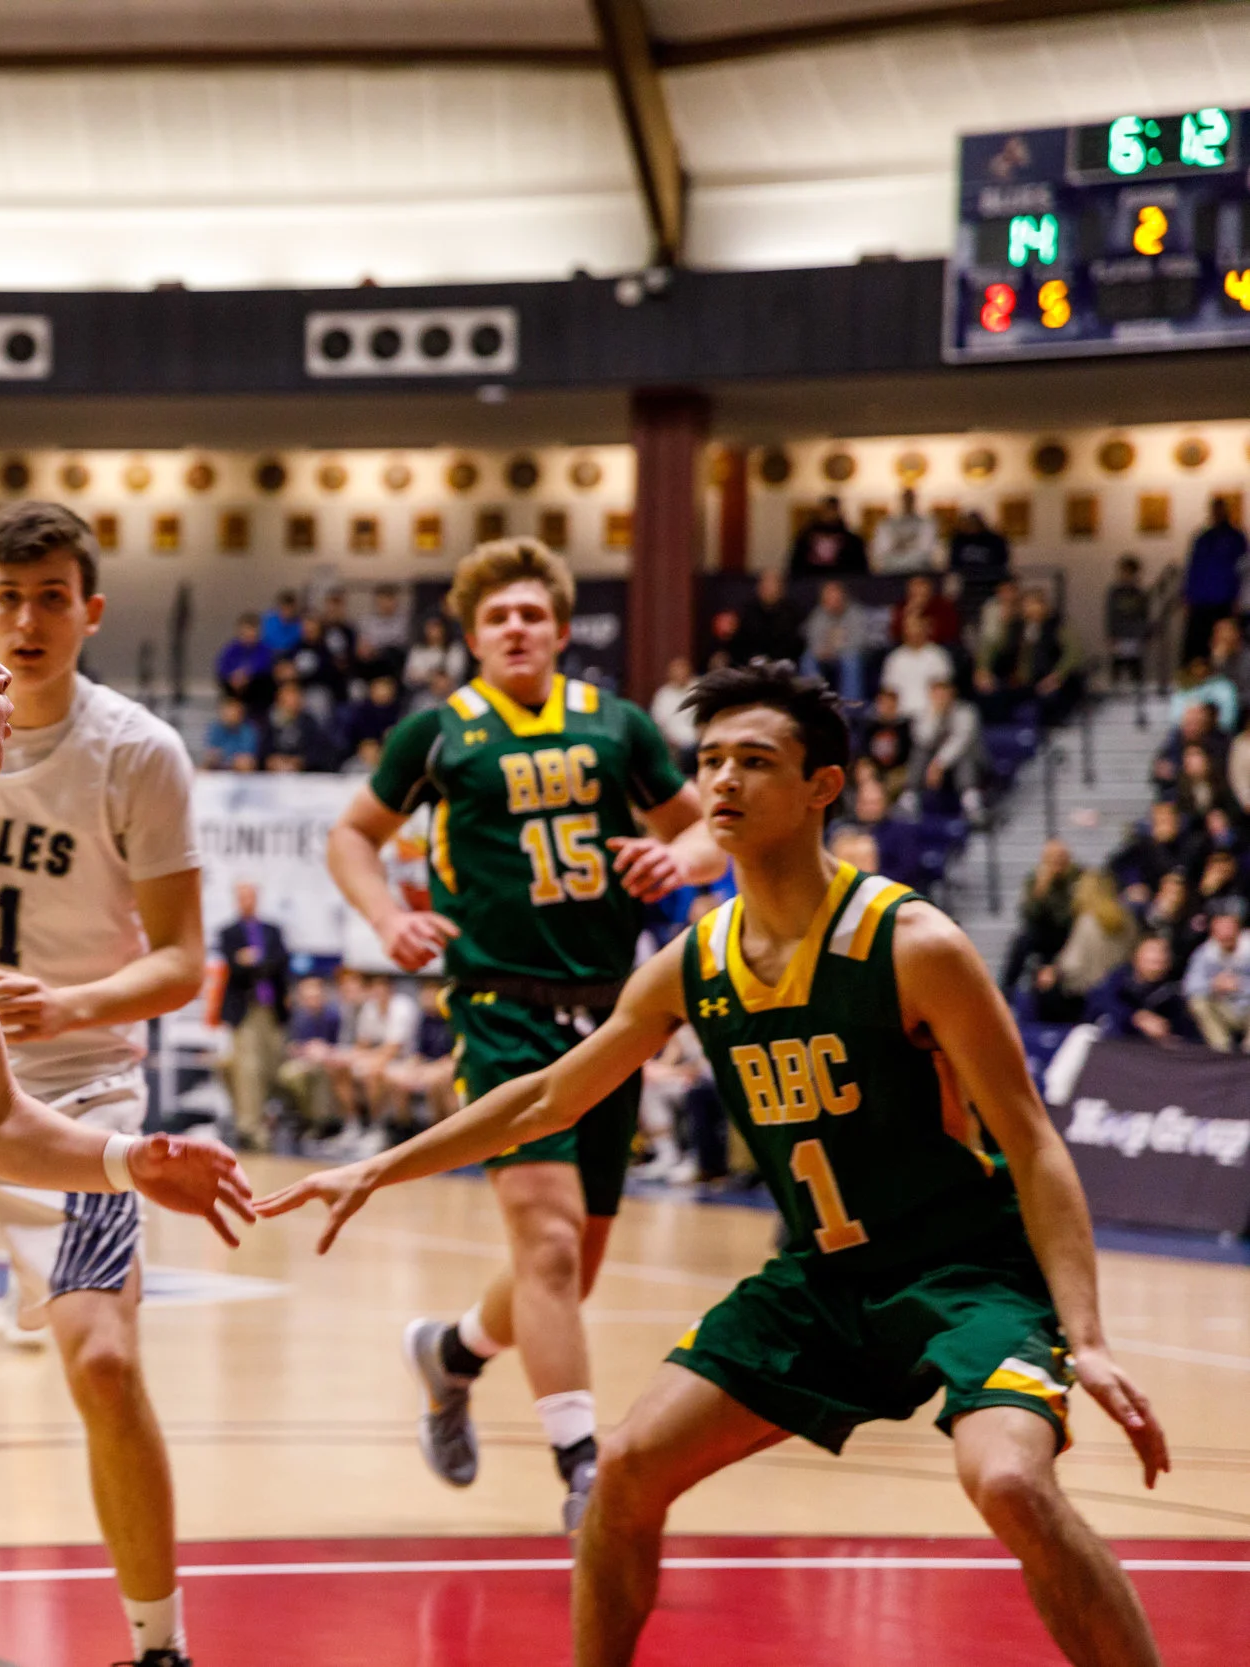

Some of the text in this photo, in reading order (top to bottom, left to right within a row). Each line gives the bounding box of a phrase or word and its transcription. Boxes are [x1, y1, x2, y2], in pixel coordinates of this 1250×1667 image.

[1108, 107, 1231, 175] 6:12
[519, 812, 609, 907] 15
[789, 1138, 869, 1254] 1
